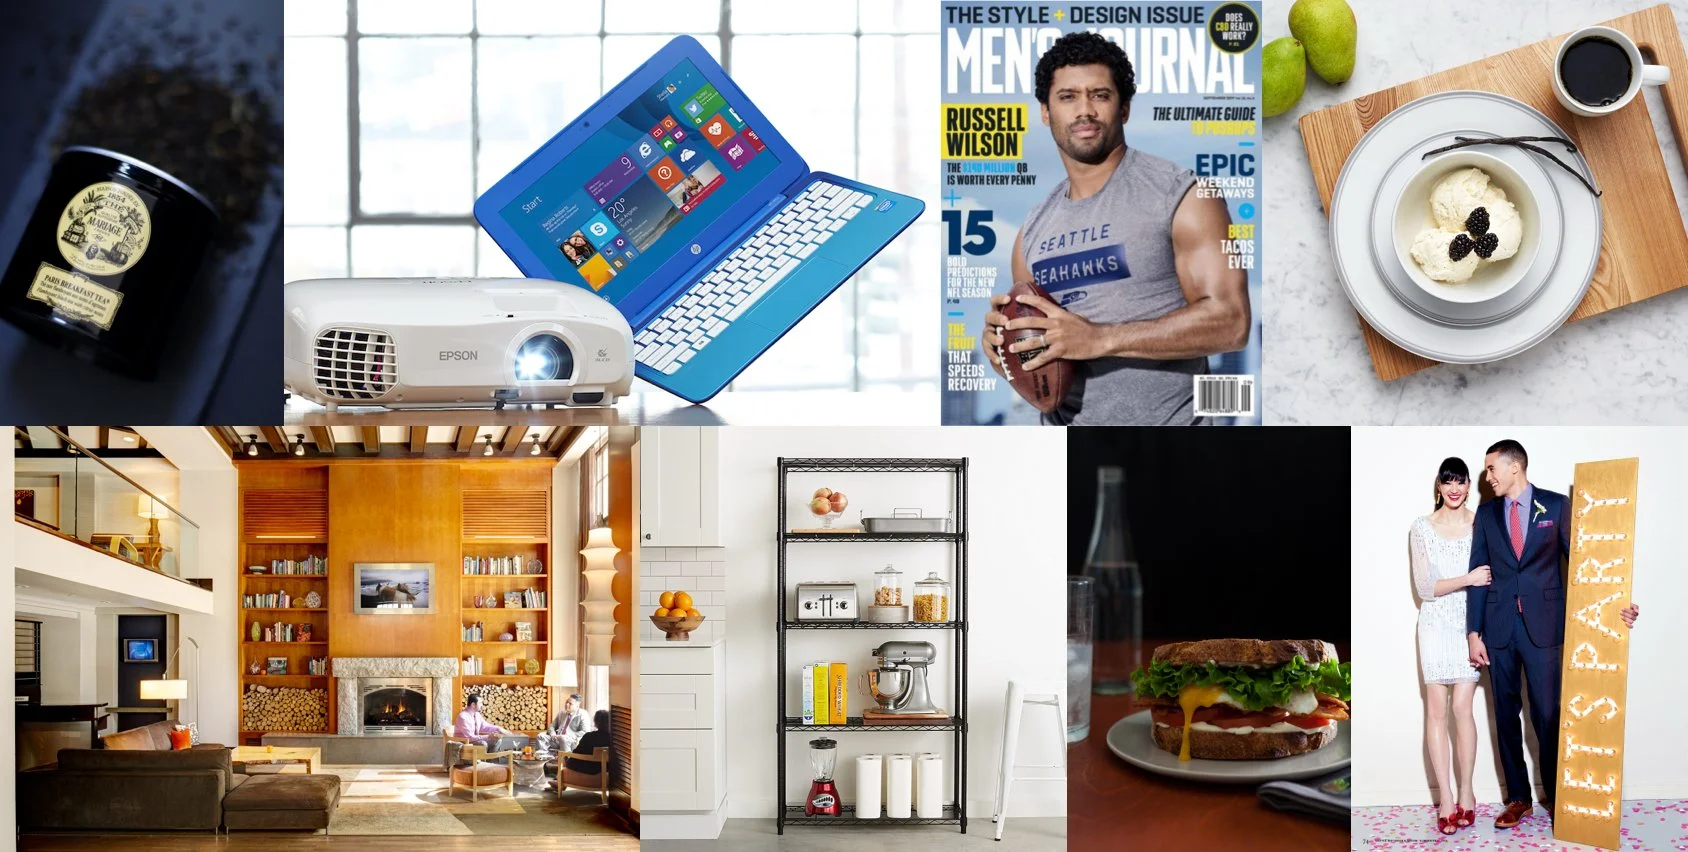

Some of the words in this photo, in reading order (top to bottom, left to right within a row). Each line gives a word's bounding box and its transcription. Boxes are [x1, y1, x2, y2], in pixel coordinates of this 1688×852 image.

[945, 6, 984, 24] THE
[988, 6, 1050, 24] STYLE
[1070, 6, 1141, 24] DESIGN
[1147, 6, 1205, 24] ISSUE
[1225, 13, 1243, 22] DOES
[1230, 22, 1253, 31] REALLY
[1222, 31, 1247, 40] WORK?
[1085, 27, 1255, 94] URNAL
[946, 107, 1025, 132] RUSSELL
[1153, 106, 1172, 121] THE
[1173, 106, 1223, 121] ULTIMATE
[1224, 106, 1256, 121] GUIDE
[946, 132, 1018, 157] WILSON
[947, 162, 962, 173] THE
[1016, 162, 1028, 174] QB
[1196, 153, 1255, 177] EPIC
[947, 175, 955, 185] IS
[957, 175, 985, 185] WORTH
[986, 175, 1010, 185] EVERY
[1011, 175, 1037, 185] PENNY
[1196, 177, 1255, 188] WEEKEND
[1196, 188, 1255, 199] GETAWAYS
[521, 195, 543, 214] Start
[87, 215, 122, 236] MARIAGE
[1228, 224, 1255, 239] BEST
[941, 210, 997, 256] 15
[1039, 223, 1111, 255] SEATTLE
[1220, 239, 1255, 254] TACOS
[947, 256, 967, 267] BOLD
[1228, 255, 1255, 269] EVER
[947, 267, 997, 277] PREDICTIONS
[1034, 255, 1119, 286] SEAHAWKS
[44, 274, 60, 285] PARIS
[60, 279, 95, 299] BREAKFAST
[947, 277, 963, 288] FOR
[963, 277, 976, 288] THE
[977, 277, 996, 288] NEW
[947, 288, 960, 298] NFL
[961, 288, 992, 298] SEASON
[947, 323, 965, 337] THE
[947, 337, 976, 350] FRUIT
[439, 350, 478, 361] EPSON
[947, 351, 972, 363] THAT
[948, 364, 985, 377] SPEEDS
[948, 378, 997, 391] RECOVERY
[1570, 488, 1630, 672] PARTY
[1562, 694, 1619, 820] LET'S
